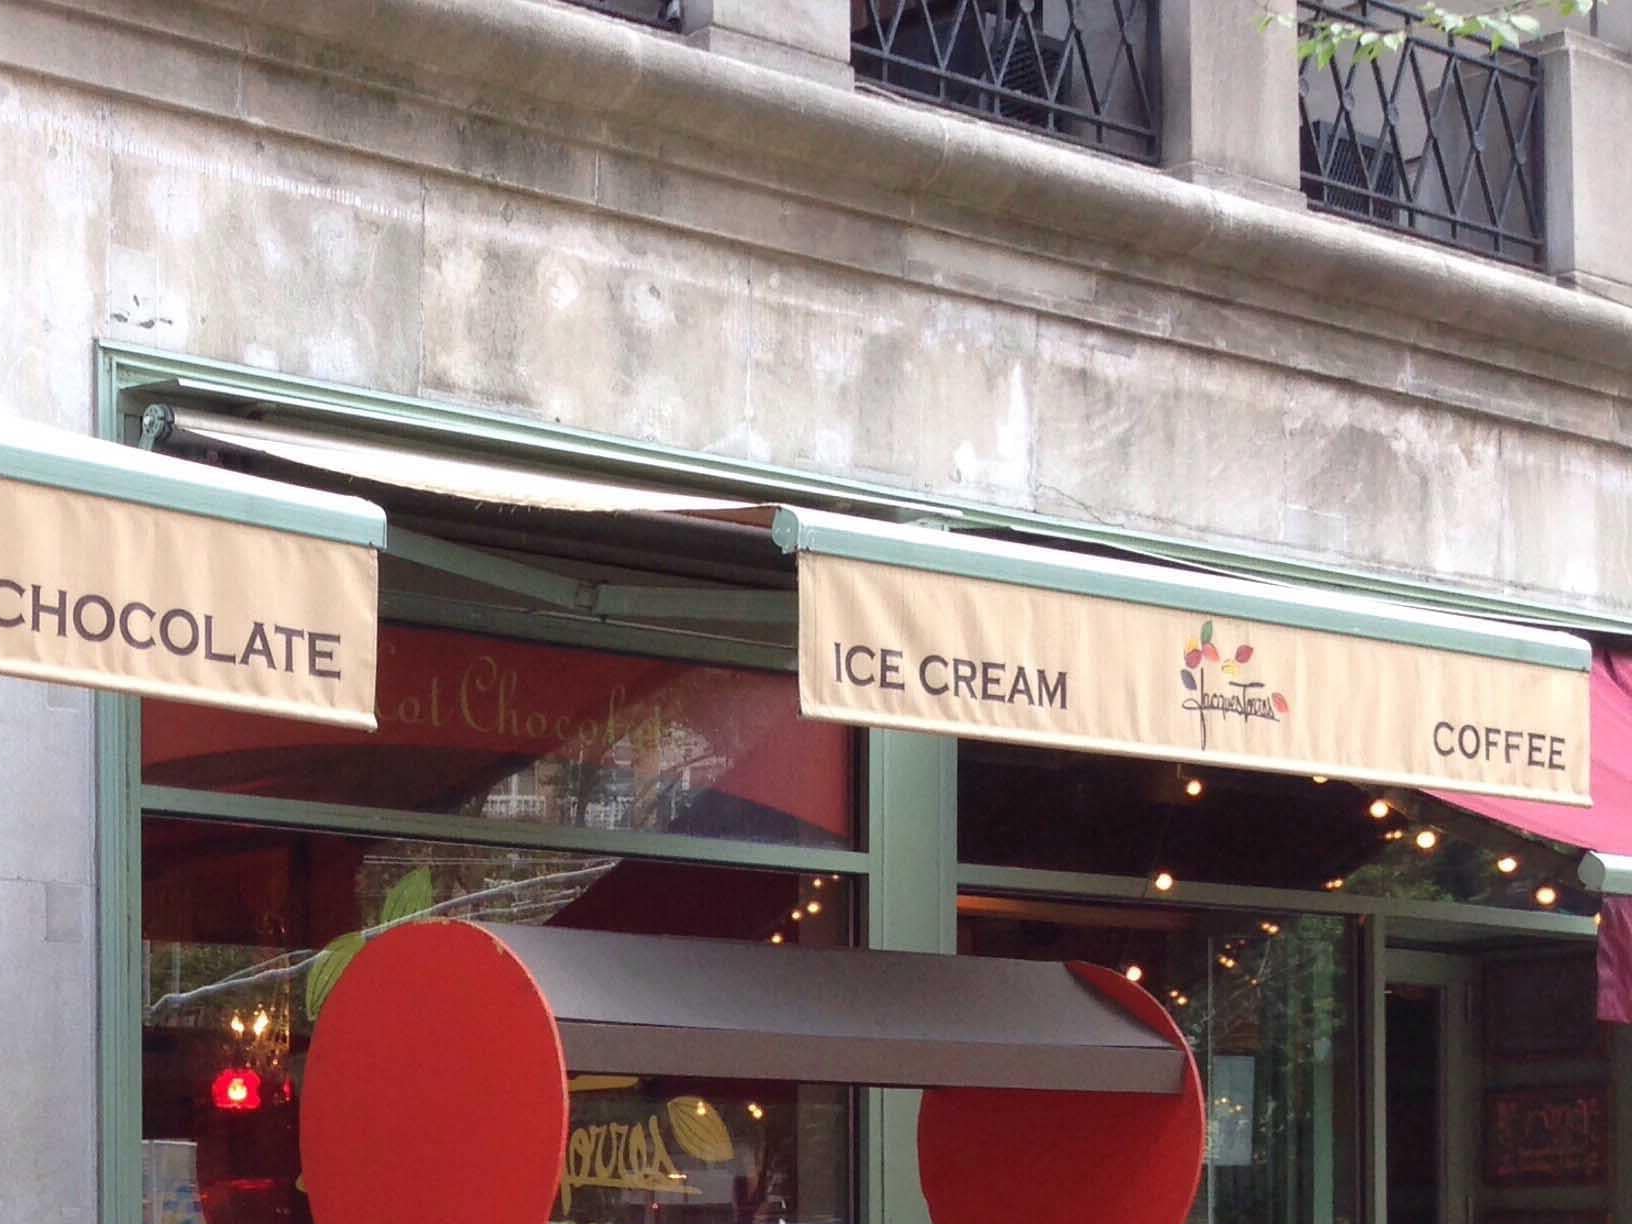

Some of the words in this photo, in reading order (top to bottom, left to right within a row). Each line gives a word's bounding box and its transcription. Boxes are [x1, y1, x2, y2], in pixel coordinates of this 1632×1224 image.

[834, 642, 905, 690] ICE
[919, 655, 1068, 710] CREAM
[1433, 721, 1566, 771] COFFEE
